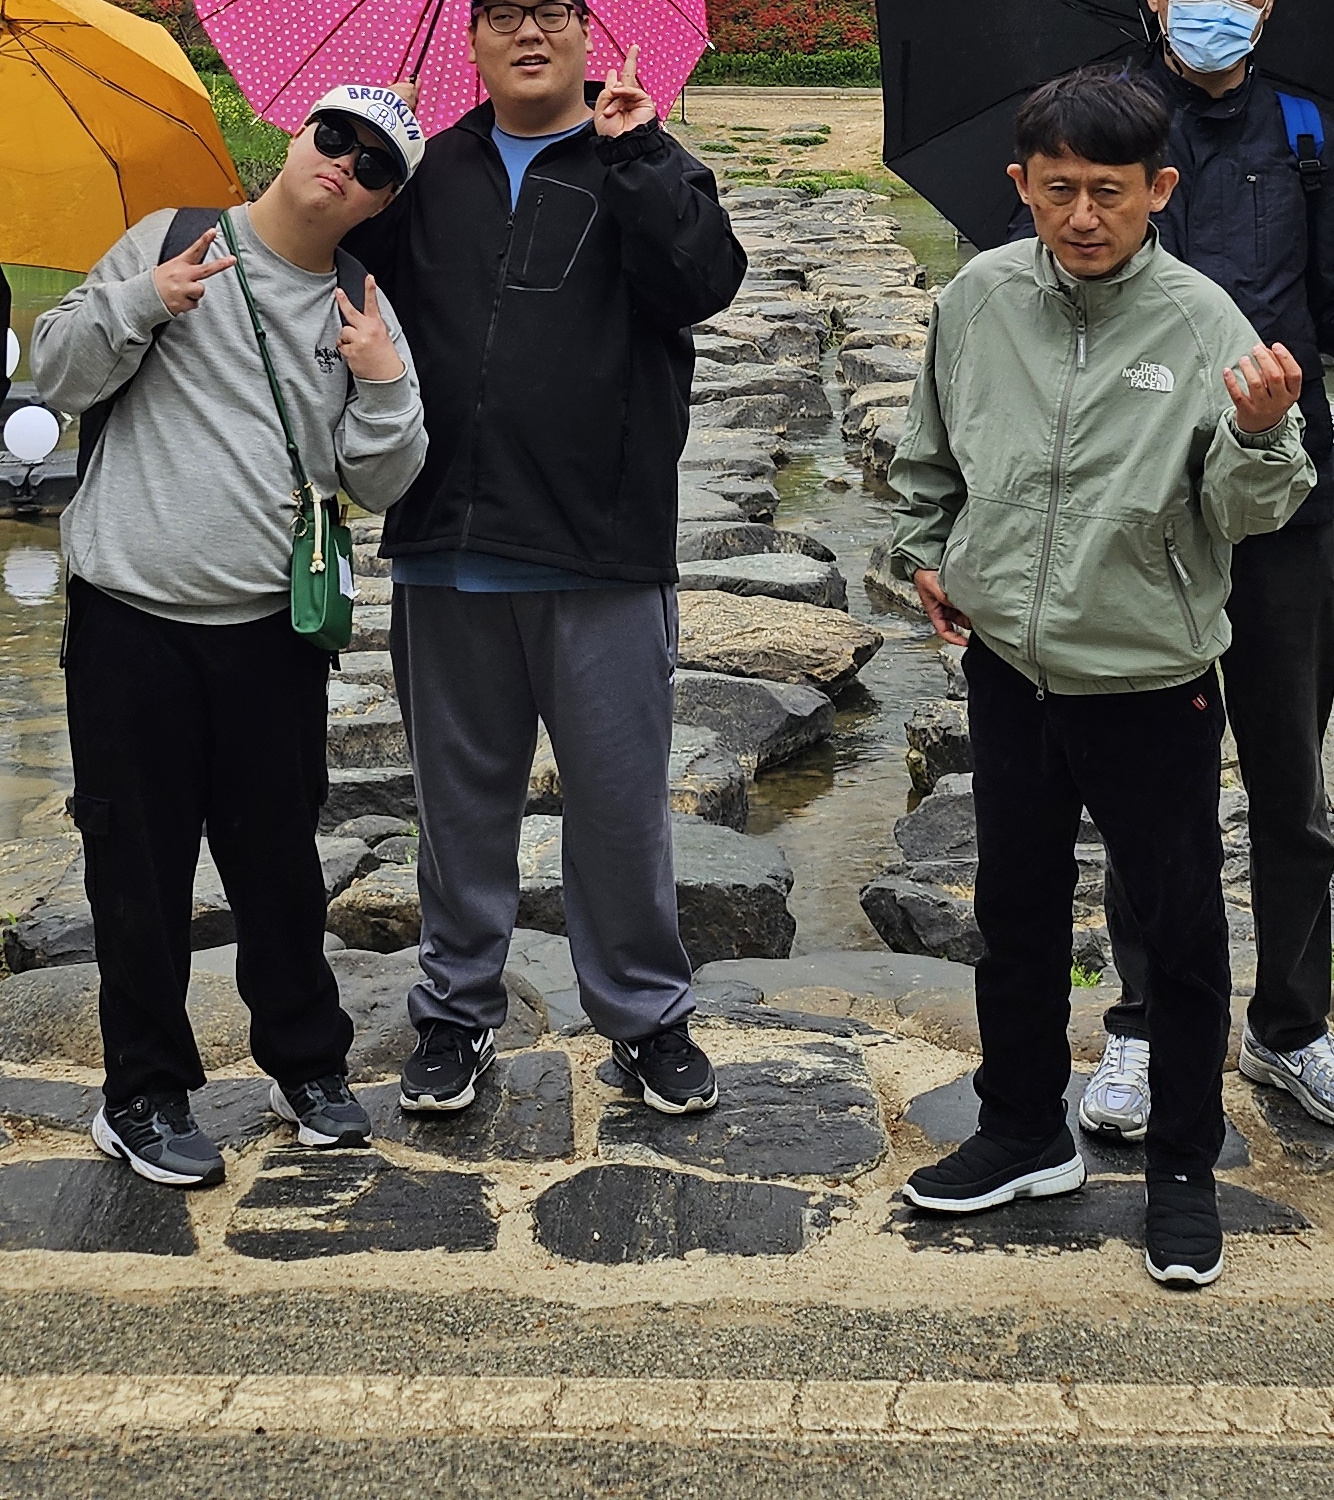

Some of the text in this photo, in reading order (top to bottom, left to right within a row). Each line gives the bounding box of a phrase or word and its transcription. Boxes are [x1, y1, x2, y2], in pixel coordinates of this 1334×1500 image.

[347, 87, 421, 141] BROOKLYN
[1121, 367, 1158, 382] NORTH
[1139, 361, 1159, 374] THE
[1130, 377, 1158, 390] FACE
